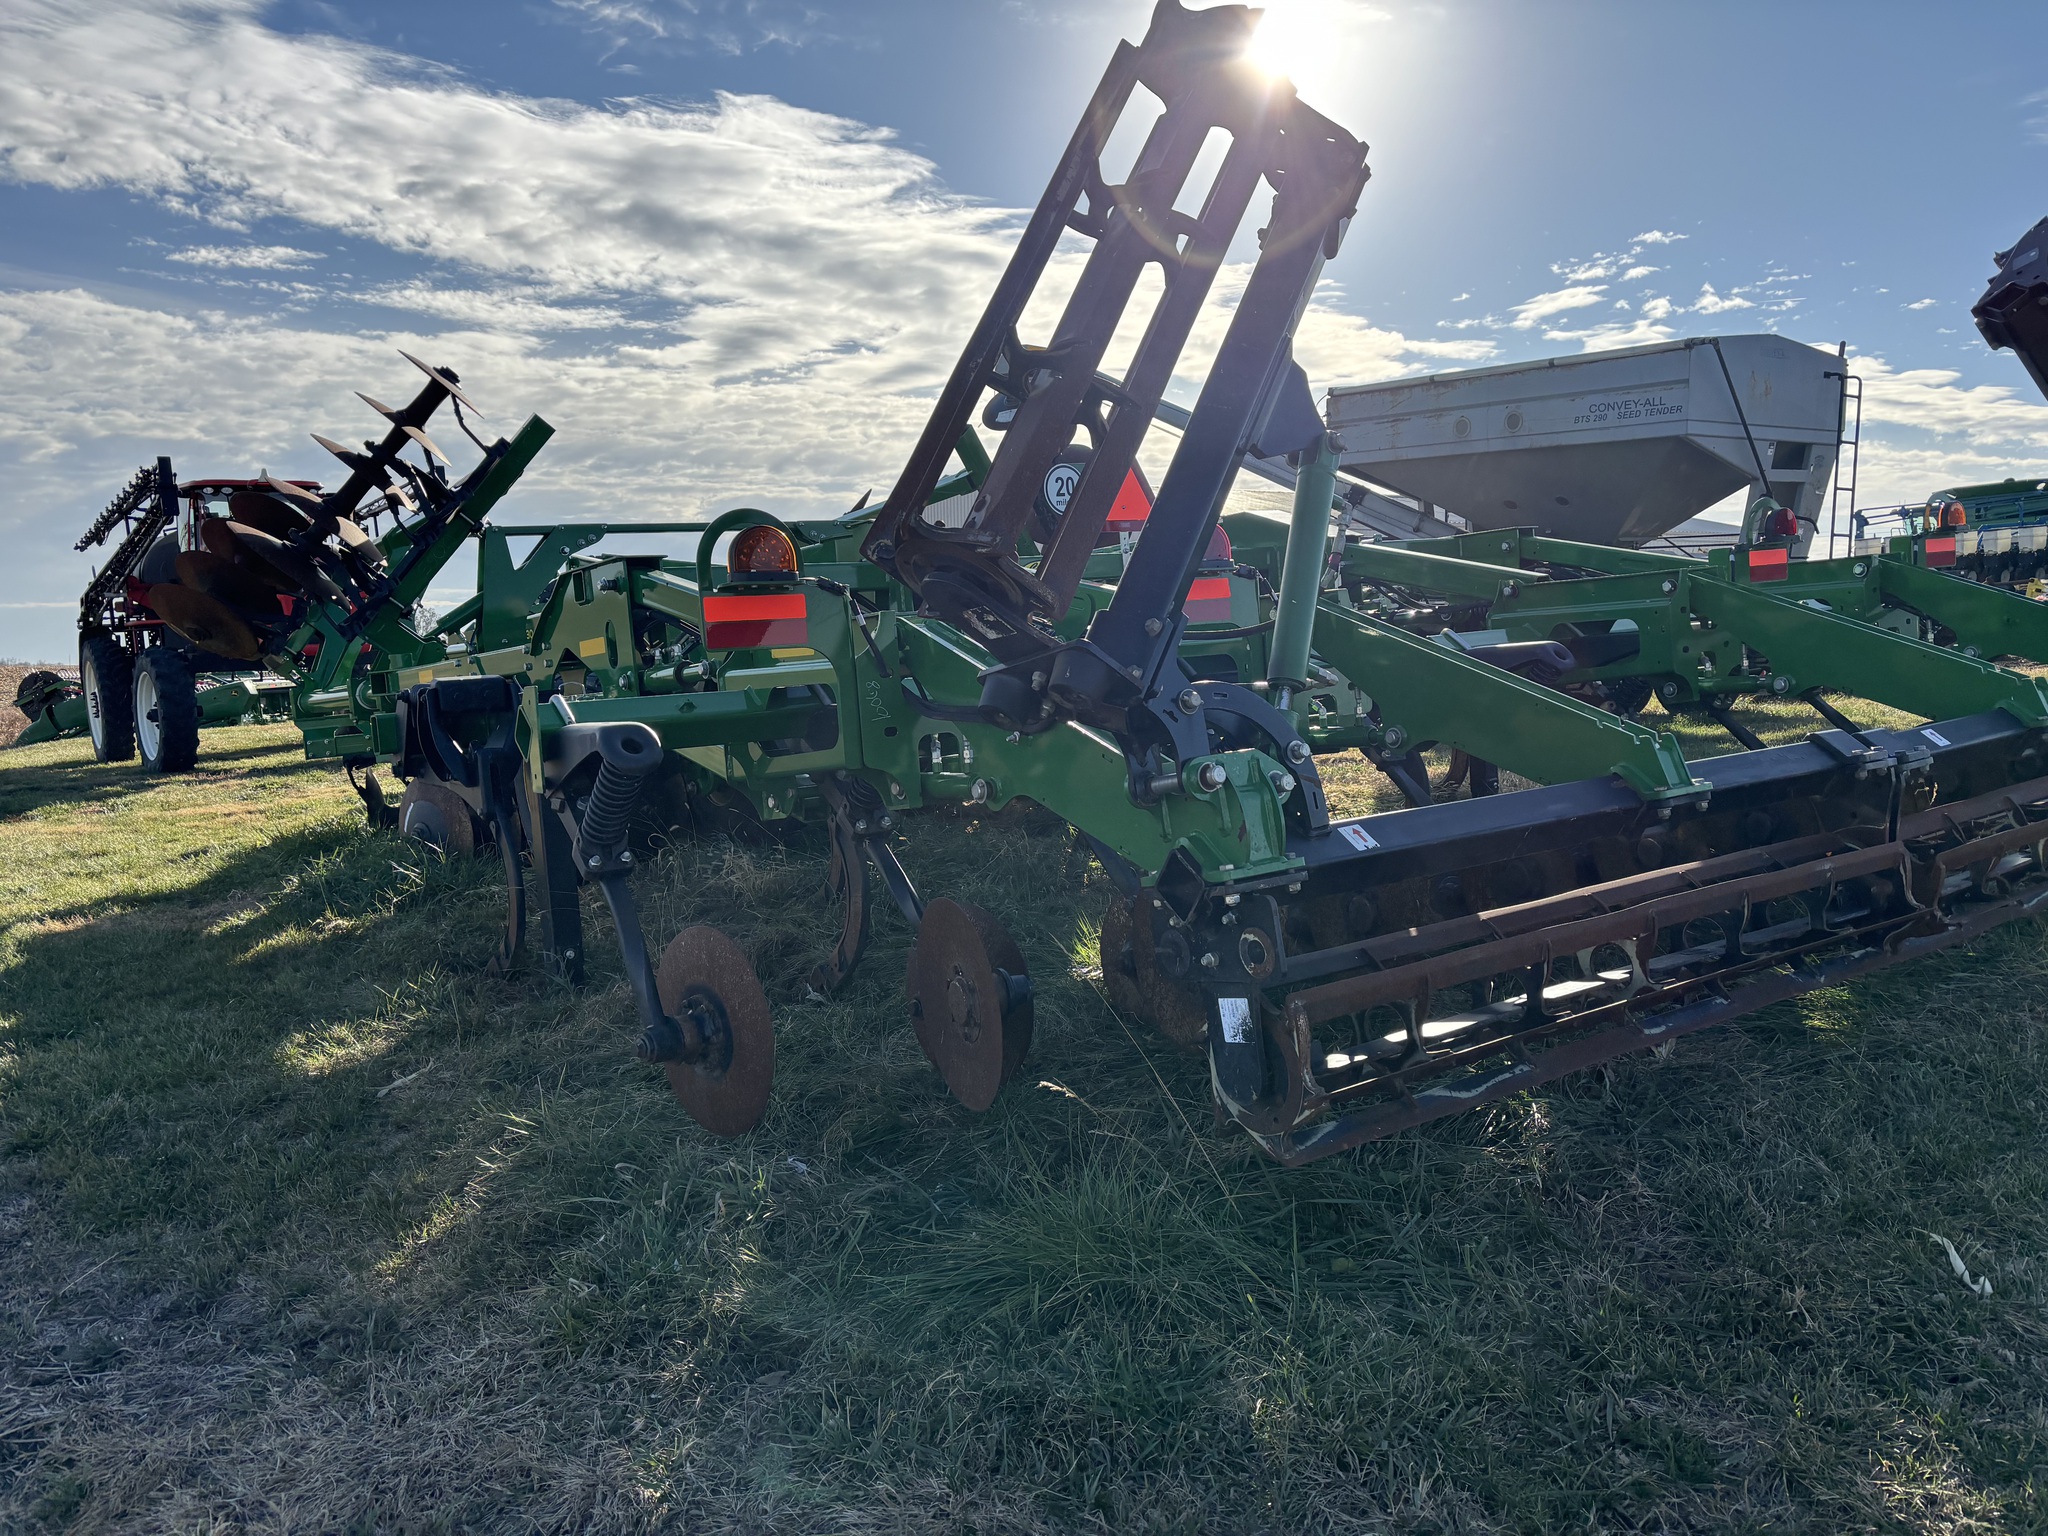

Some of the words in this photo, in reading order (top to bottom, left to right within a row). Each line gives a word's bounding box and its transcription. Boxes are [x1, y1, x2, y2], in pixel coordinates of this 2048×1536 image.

[1589, 396, 1666, 413] CONVEY-ALL
[1574, 415, 1591, 424] BTS
[1593, 413, 1608, 423] 290
[1617, 409, 1642, 420] SEED
[1644, 405, 1683, 417] TENDER
[1055, 476, 1075, 497] 20
[1056, 498, 1068, 506] mil
